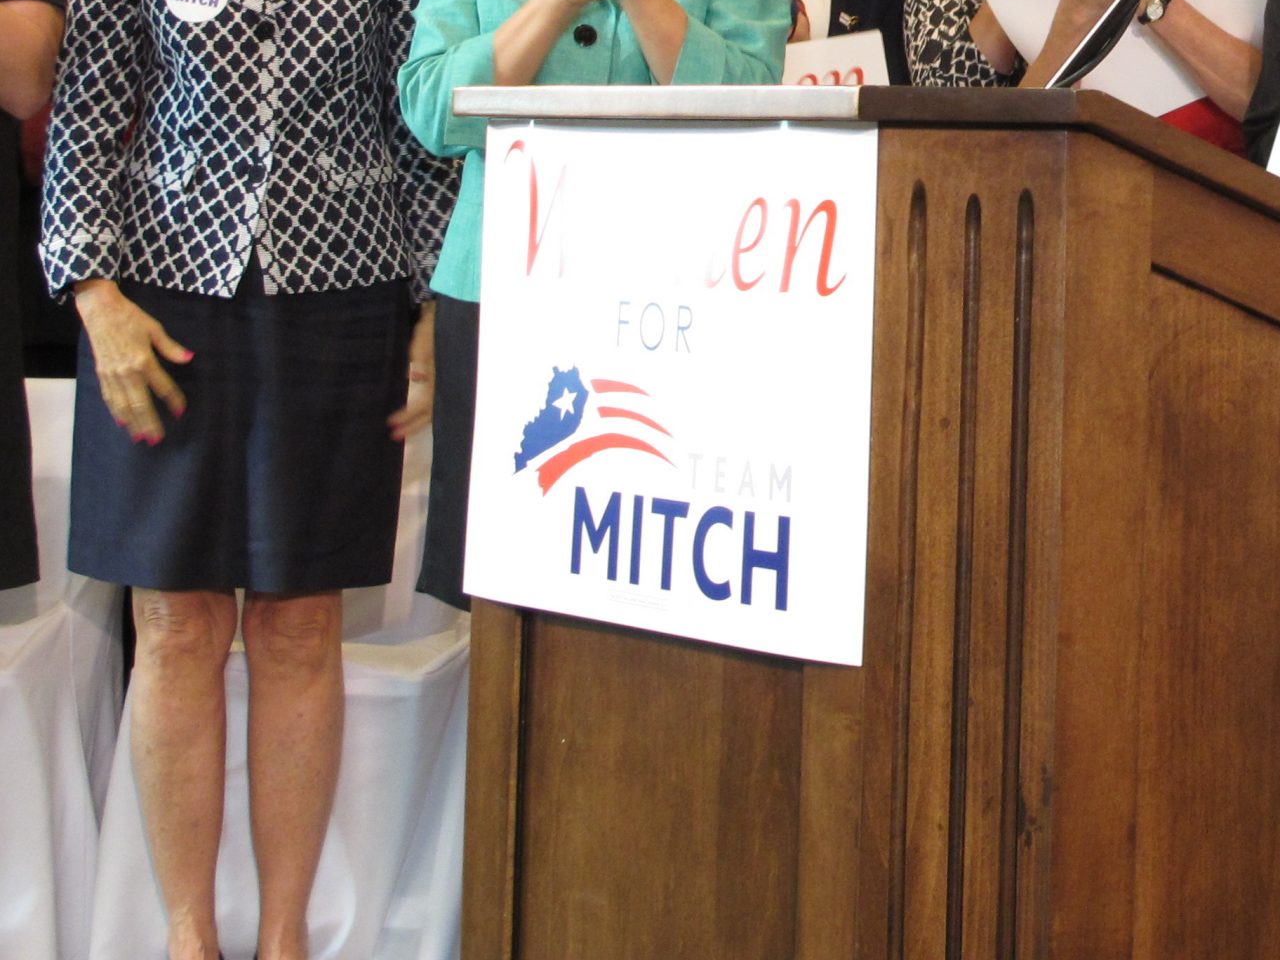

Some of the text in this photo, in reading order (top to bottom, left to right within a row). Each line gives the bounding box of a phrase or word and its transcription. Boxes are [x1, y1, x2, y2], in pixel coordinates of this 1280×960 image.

[616, 300, 694, 354] FOR
[687, 452, 793, 503] TEAM
[570, 486, 792, 612] MITCH
